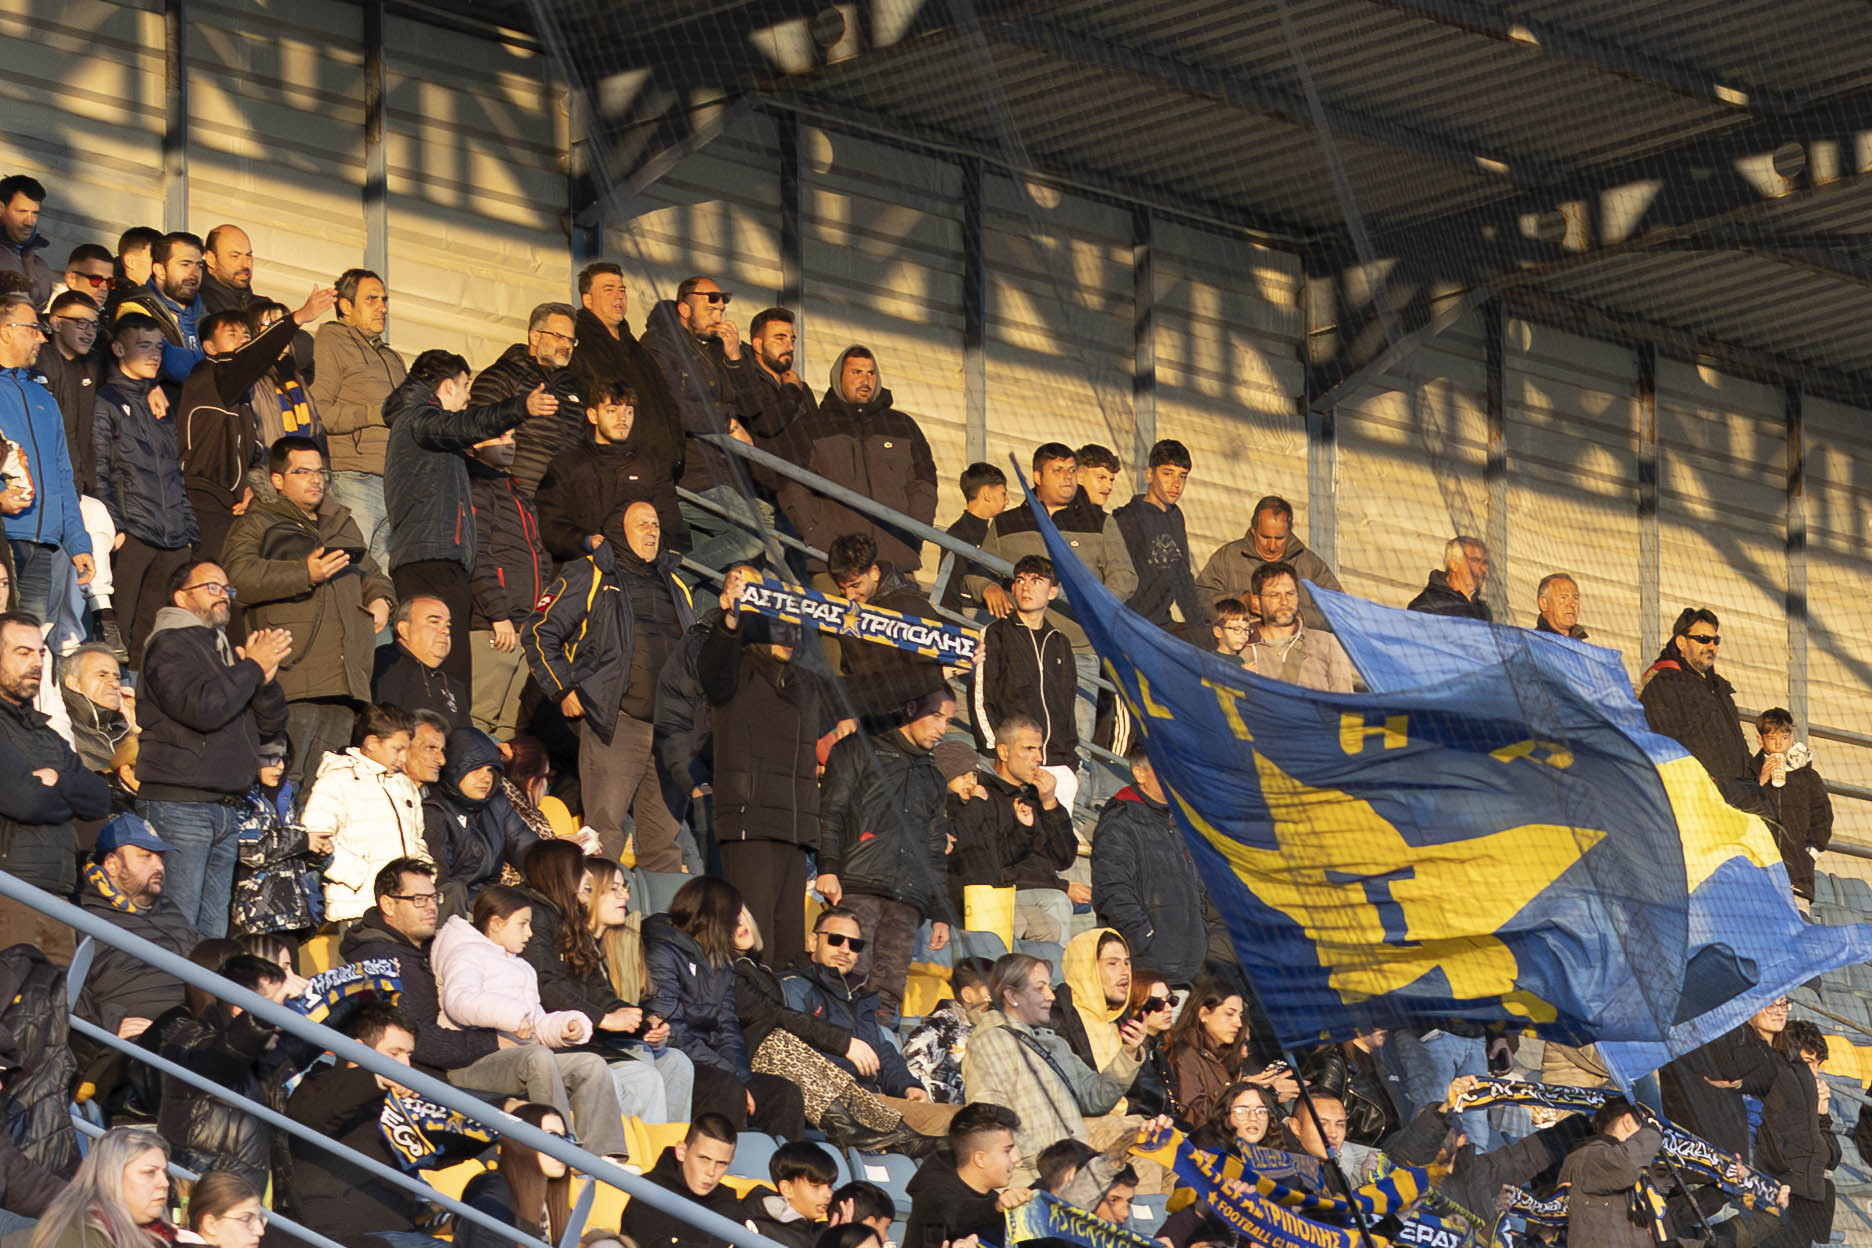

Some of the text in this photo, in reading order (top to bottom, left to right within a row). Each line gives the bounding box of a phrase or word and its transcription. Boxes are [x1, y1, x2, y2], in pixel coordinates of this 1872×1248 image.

[742, 586, 976, 658] ΑΣΤΕΡΑΣ ΤΡΙΠΟΛΗΣ
[1216, 1201, 1270, 1244] FOOTBALL
